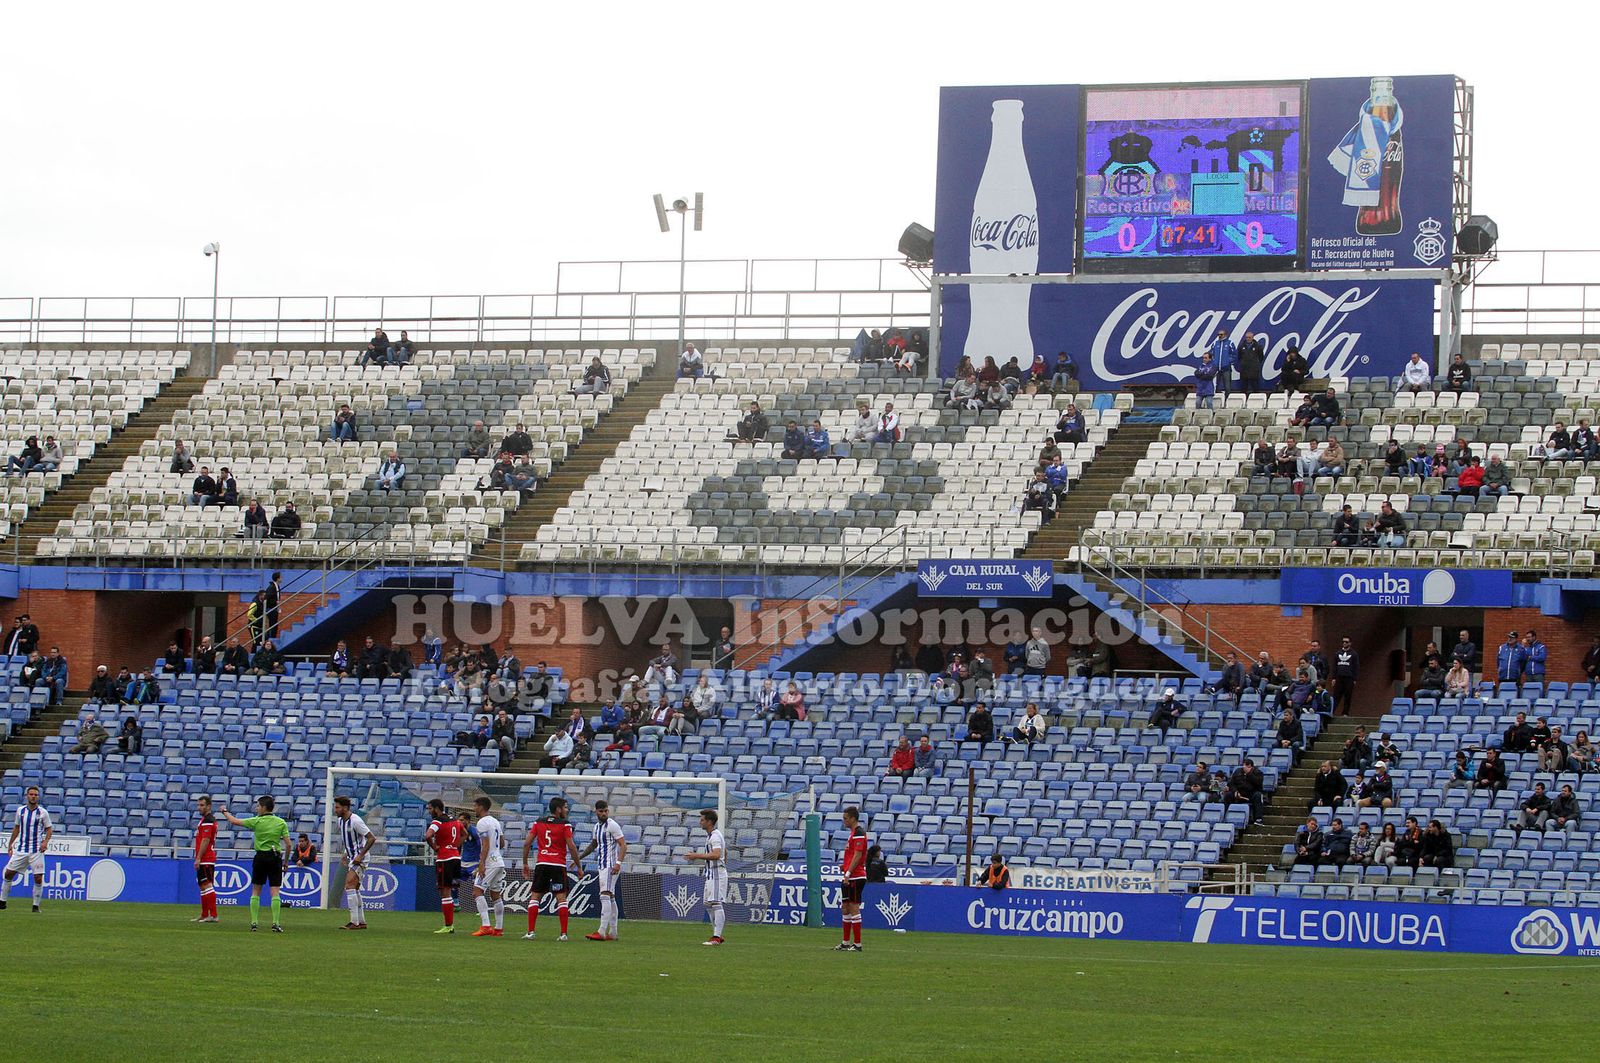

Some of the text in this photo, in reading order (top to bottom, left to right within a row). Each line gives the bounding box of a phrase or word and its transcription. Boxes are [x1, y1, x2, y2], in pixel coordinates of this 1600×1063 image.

[1087, 198, 1171, 214] Recreativo
[972, 213, 1037, 251] Coca-Cola
[1118, 221, 1264, 251] 0 07:41 0
[1311, 238, 1341, 247] Refresco
[1342, 236, 1363, 246] Oficial
[1311, 248, 1394, 259] R.C. Recreativo de Huelva
[1090, 286, 1381, 382] Coca-Cola
[949, 565, 1019, 577] CAJA RURAL
[966, 582, 1003, 591] DEL SUR
[1337, 572, 1410, 594] Onuba
[1378, 595, 1410, 605] FRUIT
[451, 826, 457, 843] 9
[544, 830, 552, 848] 5
[756, 862, 795, 873] PEÑA
[280, 872, 315, 890] KIA
[1023, 874, 1152, 890] RECREATIVISTA
[48, 889, 85, 901] FRUIT
[215, 897, 238, 905] EYSER
[726, 882, 772, 906] AJA
[749, 907, 784, 924] DEL
[967, 898, 1124, 939] Cruzcampo
[1233, 906, 1446, 947] TELEONUBA
